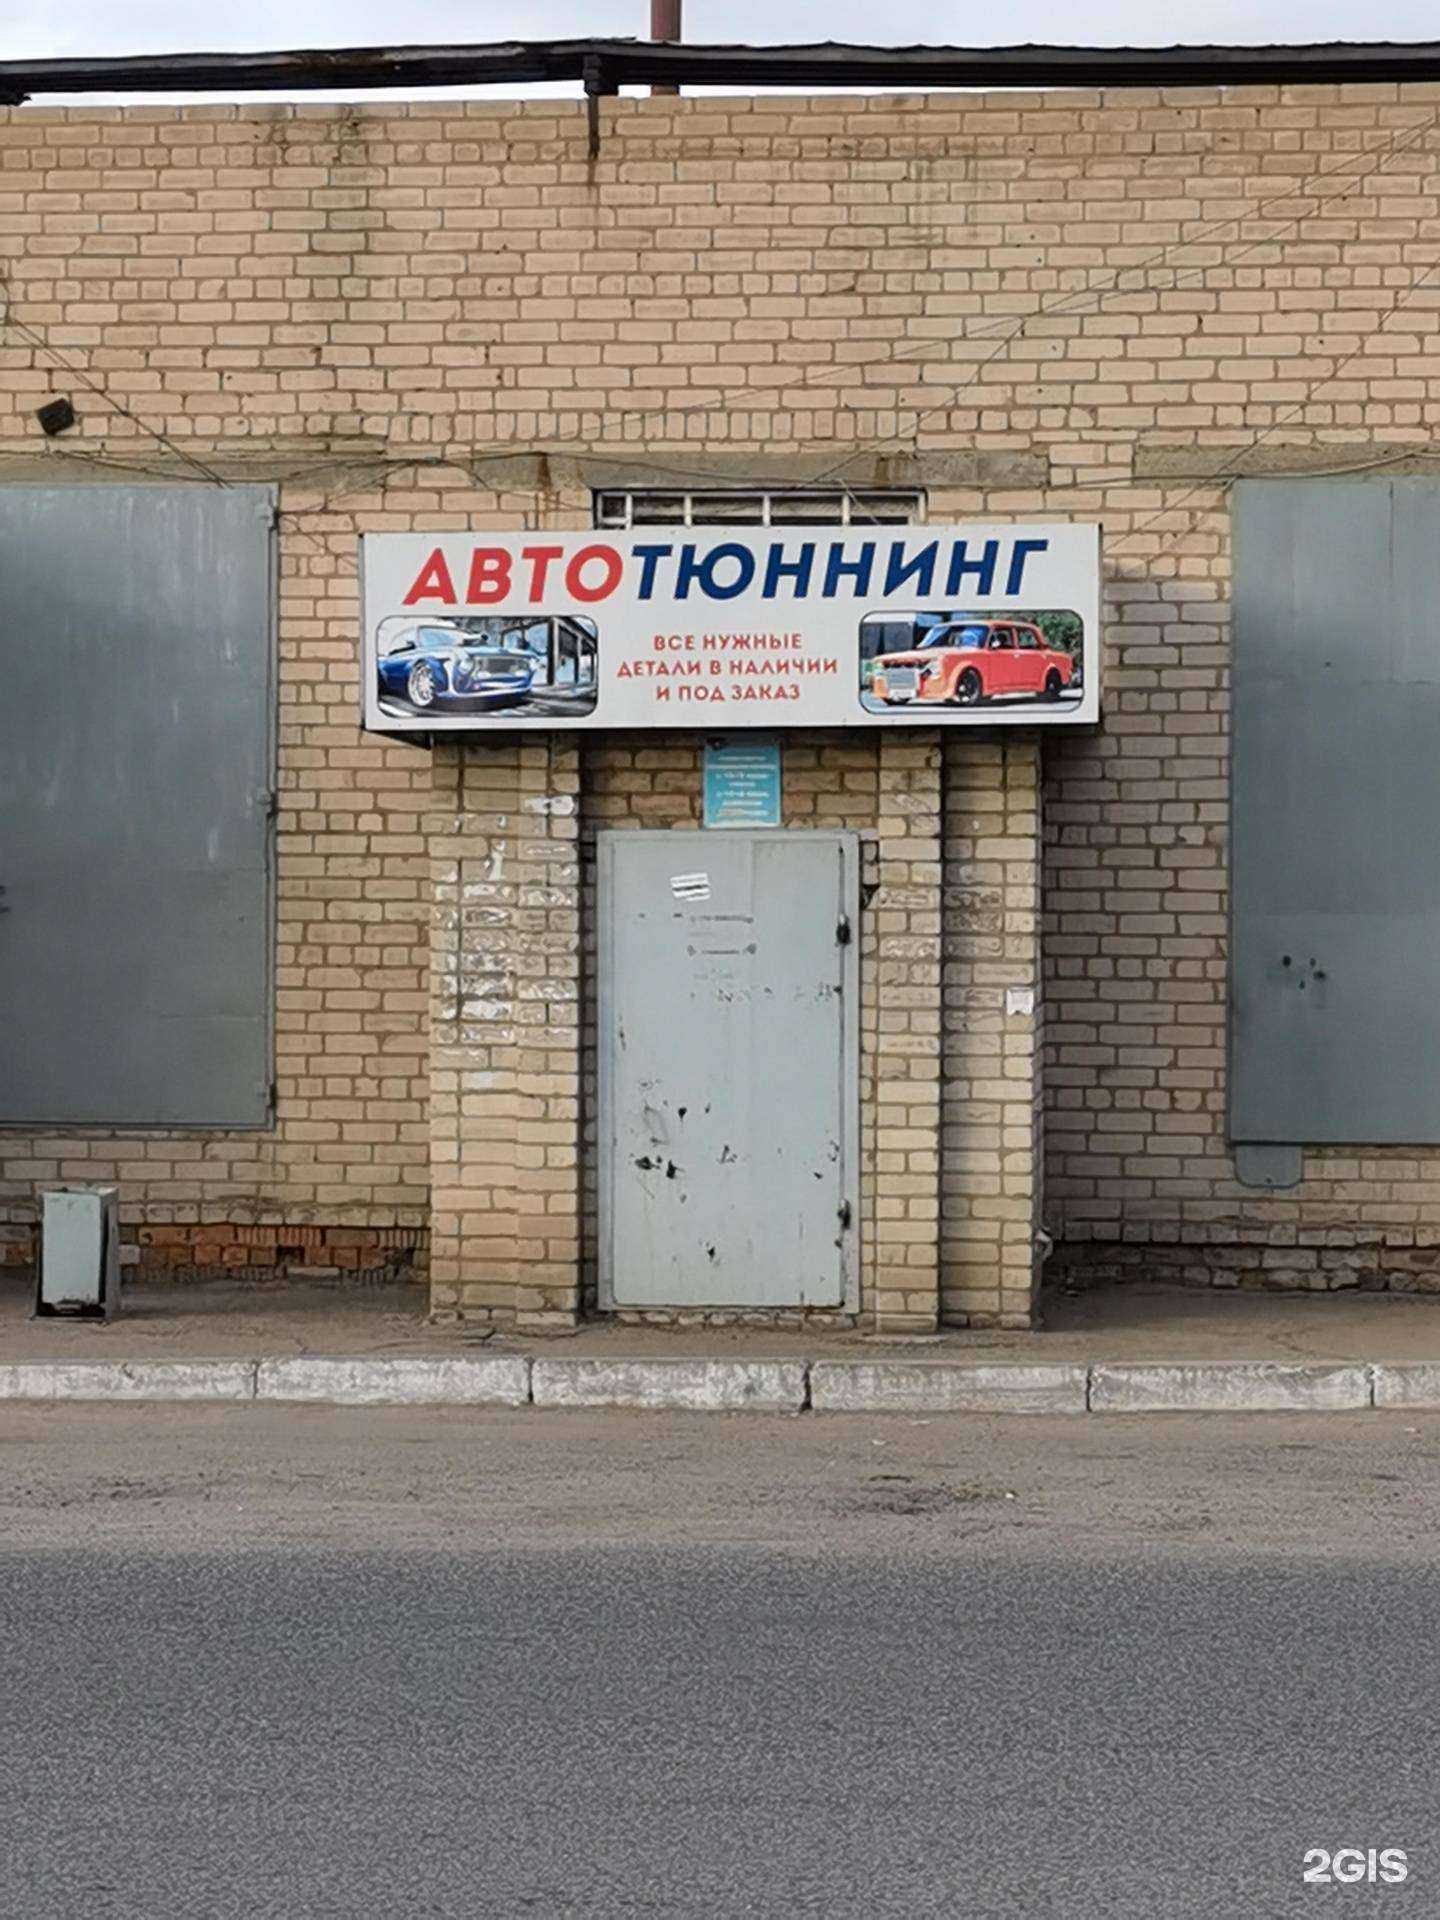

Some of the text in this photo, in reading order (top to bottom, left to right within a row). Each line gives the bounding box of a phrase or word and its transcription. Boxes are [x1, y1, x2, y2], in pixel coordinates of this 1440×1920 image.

[653, 633, 802, 651] ВСЕ НУЖНЫЕ
[617, 658, 838, 678] ДЕТАЛИ В НАЛИЧИИ
[656, 684, 801, 702] И ПОД ЗАКАЗ
